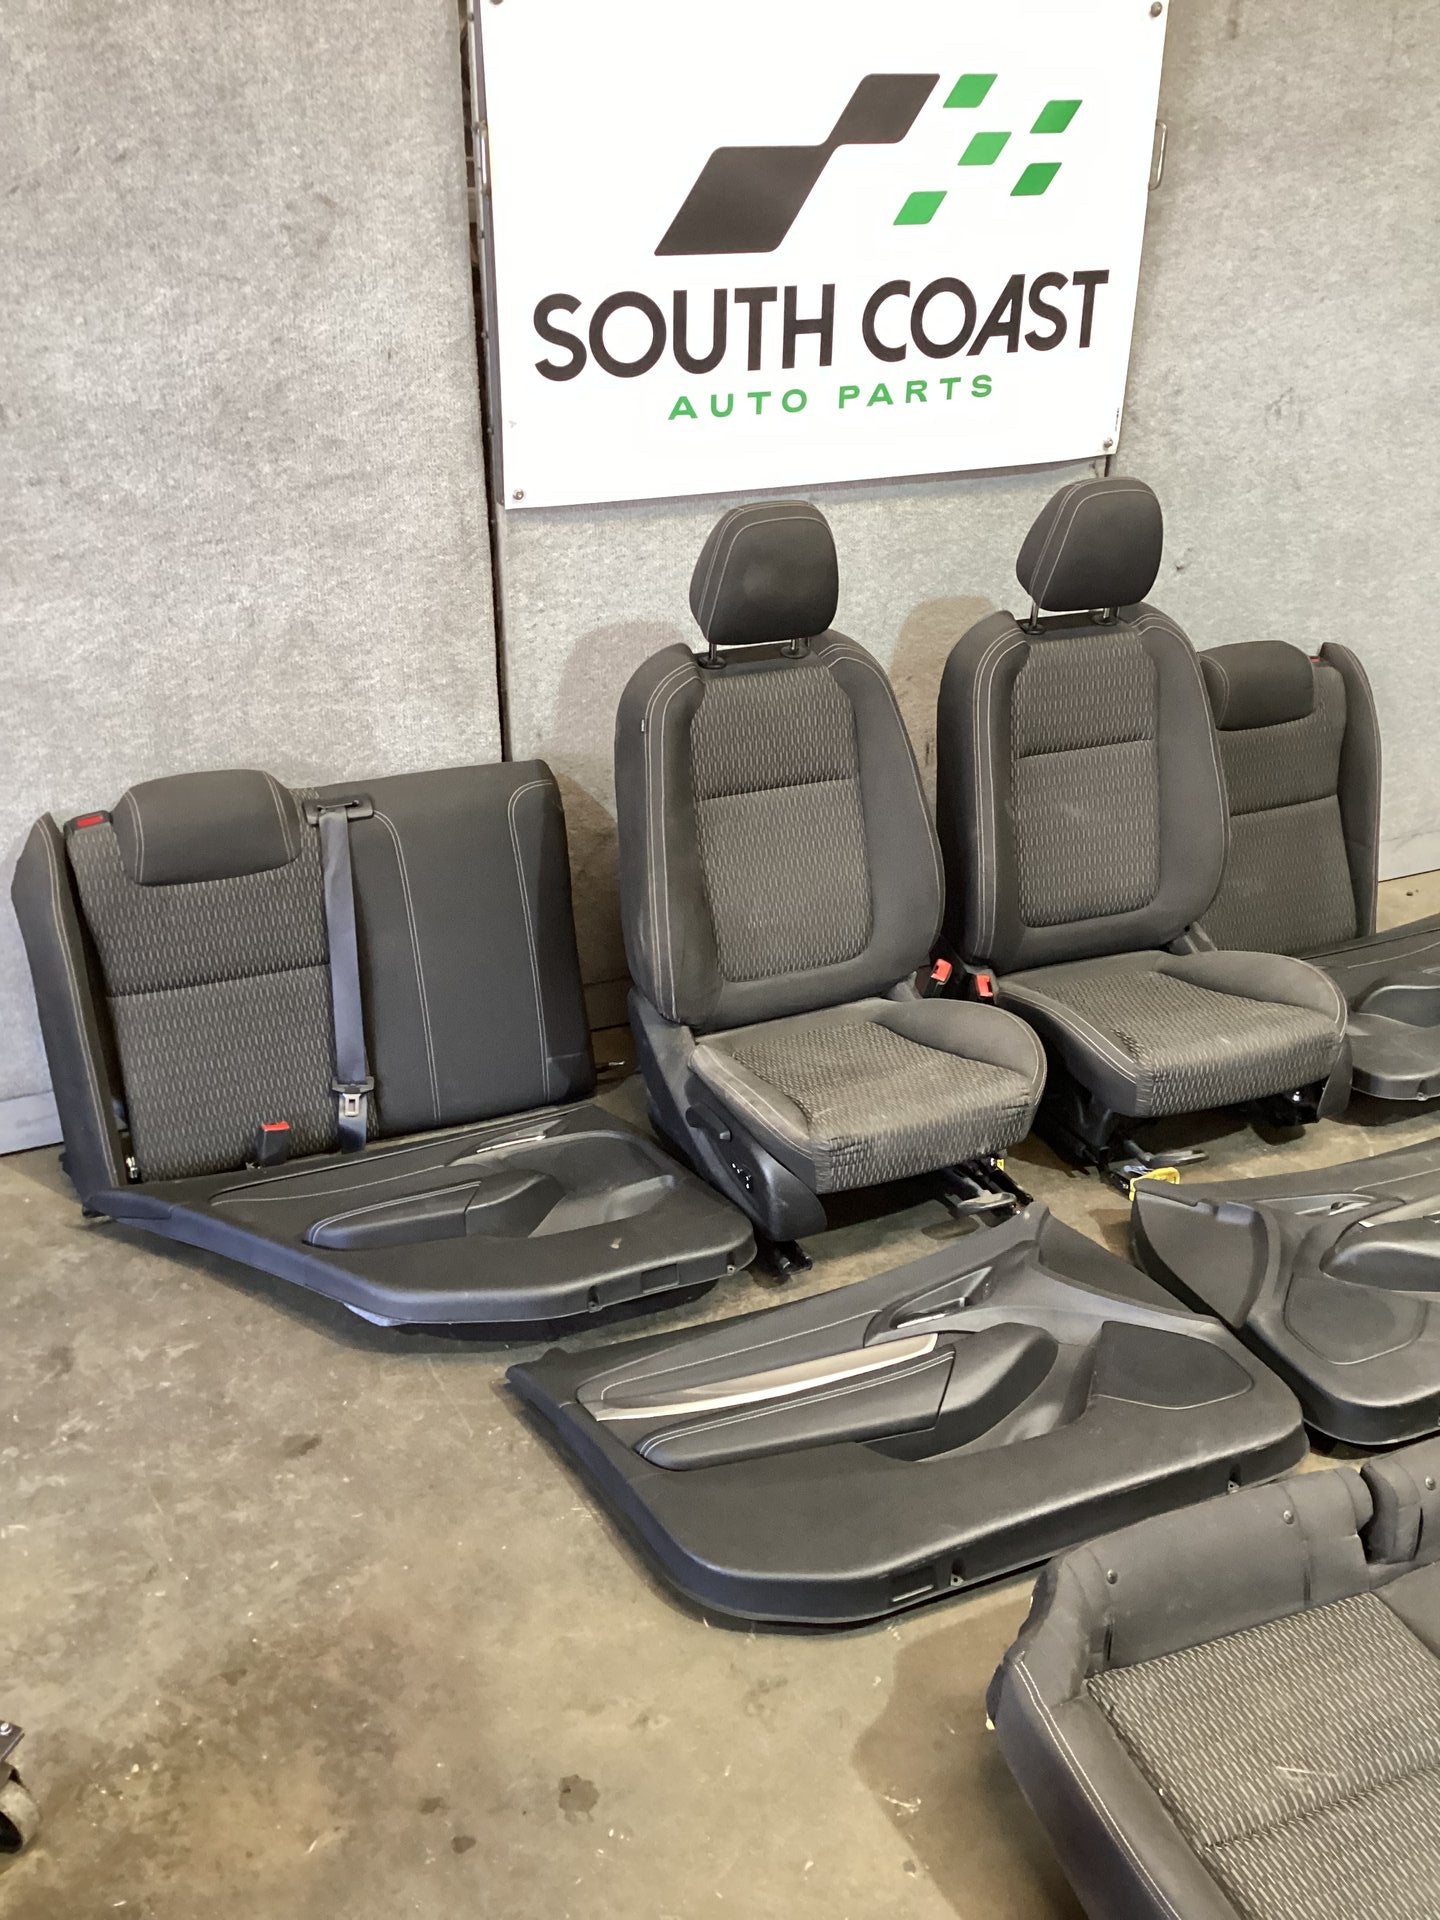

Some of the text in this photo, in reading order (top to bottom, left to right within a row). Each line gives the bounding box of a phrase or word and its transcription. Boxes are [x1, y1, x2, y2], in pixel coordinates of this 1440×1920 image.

[533, 269, 1110, 382] SOUTH COAST
[668, 374, 993, 421] AUTO PARTS
